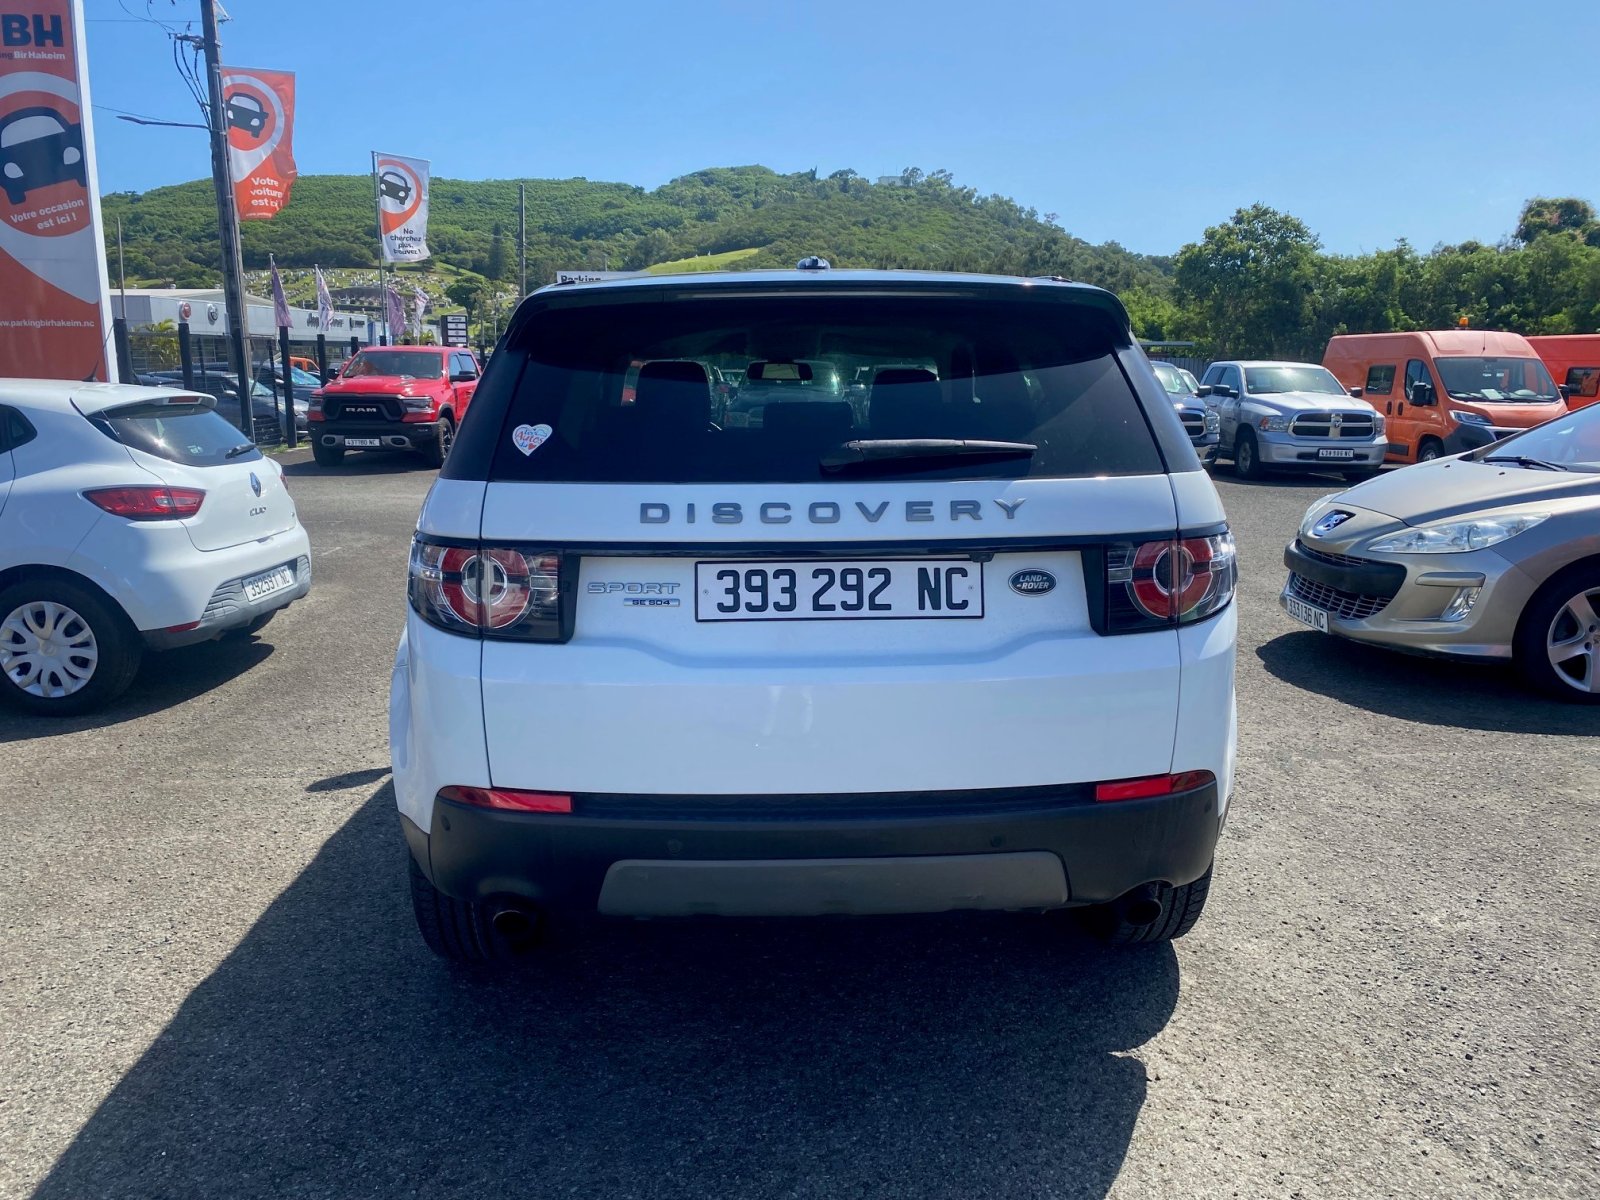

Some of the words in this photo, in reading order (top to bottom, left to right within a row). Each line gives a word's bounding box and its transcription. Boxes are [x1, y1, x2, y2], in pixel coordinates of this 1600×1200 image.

[251, 177, 279, 187] Votre
[250, 187, 283, 198] voiture
[251, 198, 269, 206] est
[10, 210, 37, 223] Votre
[40, 198, 84, 216] occasion
[37, 218, 54, 230] est
[56, 212, 71, 225] ici
[249, 506, 267, 517] CLIO
[640, 498, 1026, 524] DISCOVERY
[587, 582, 681, 595] SPORT
[716, 569, 796, 613] 393
[812, 568, 892, 612] 292
[917, 567, 969, 611] NC
[1021, 581, 1050, 590] ROVER
[1313, 610, 1324, 628] NC
